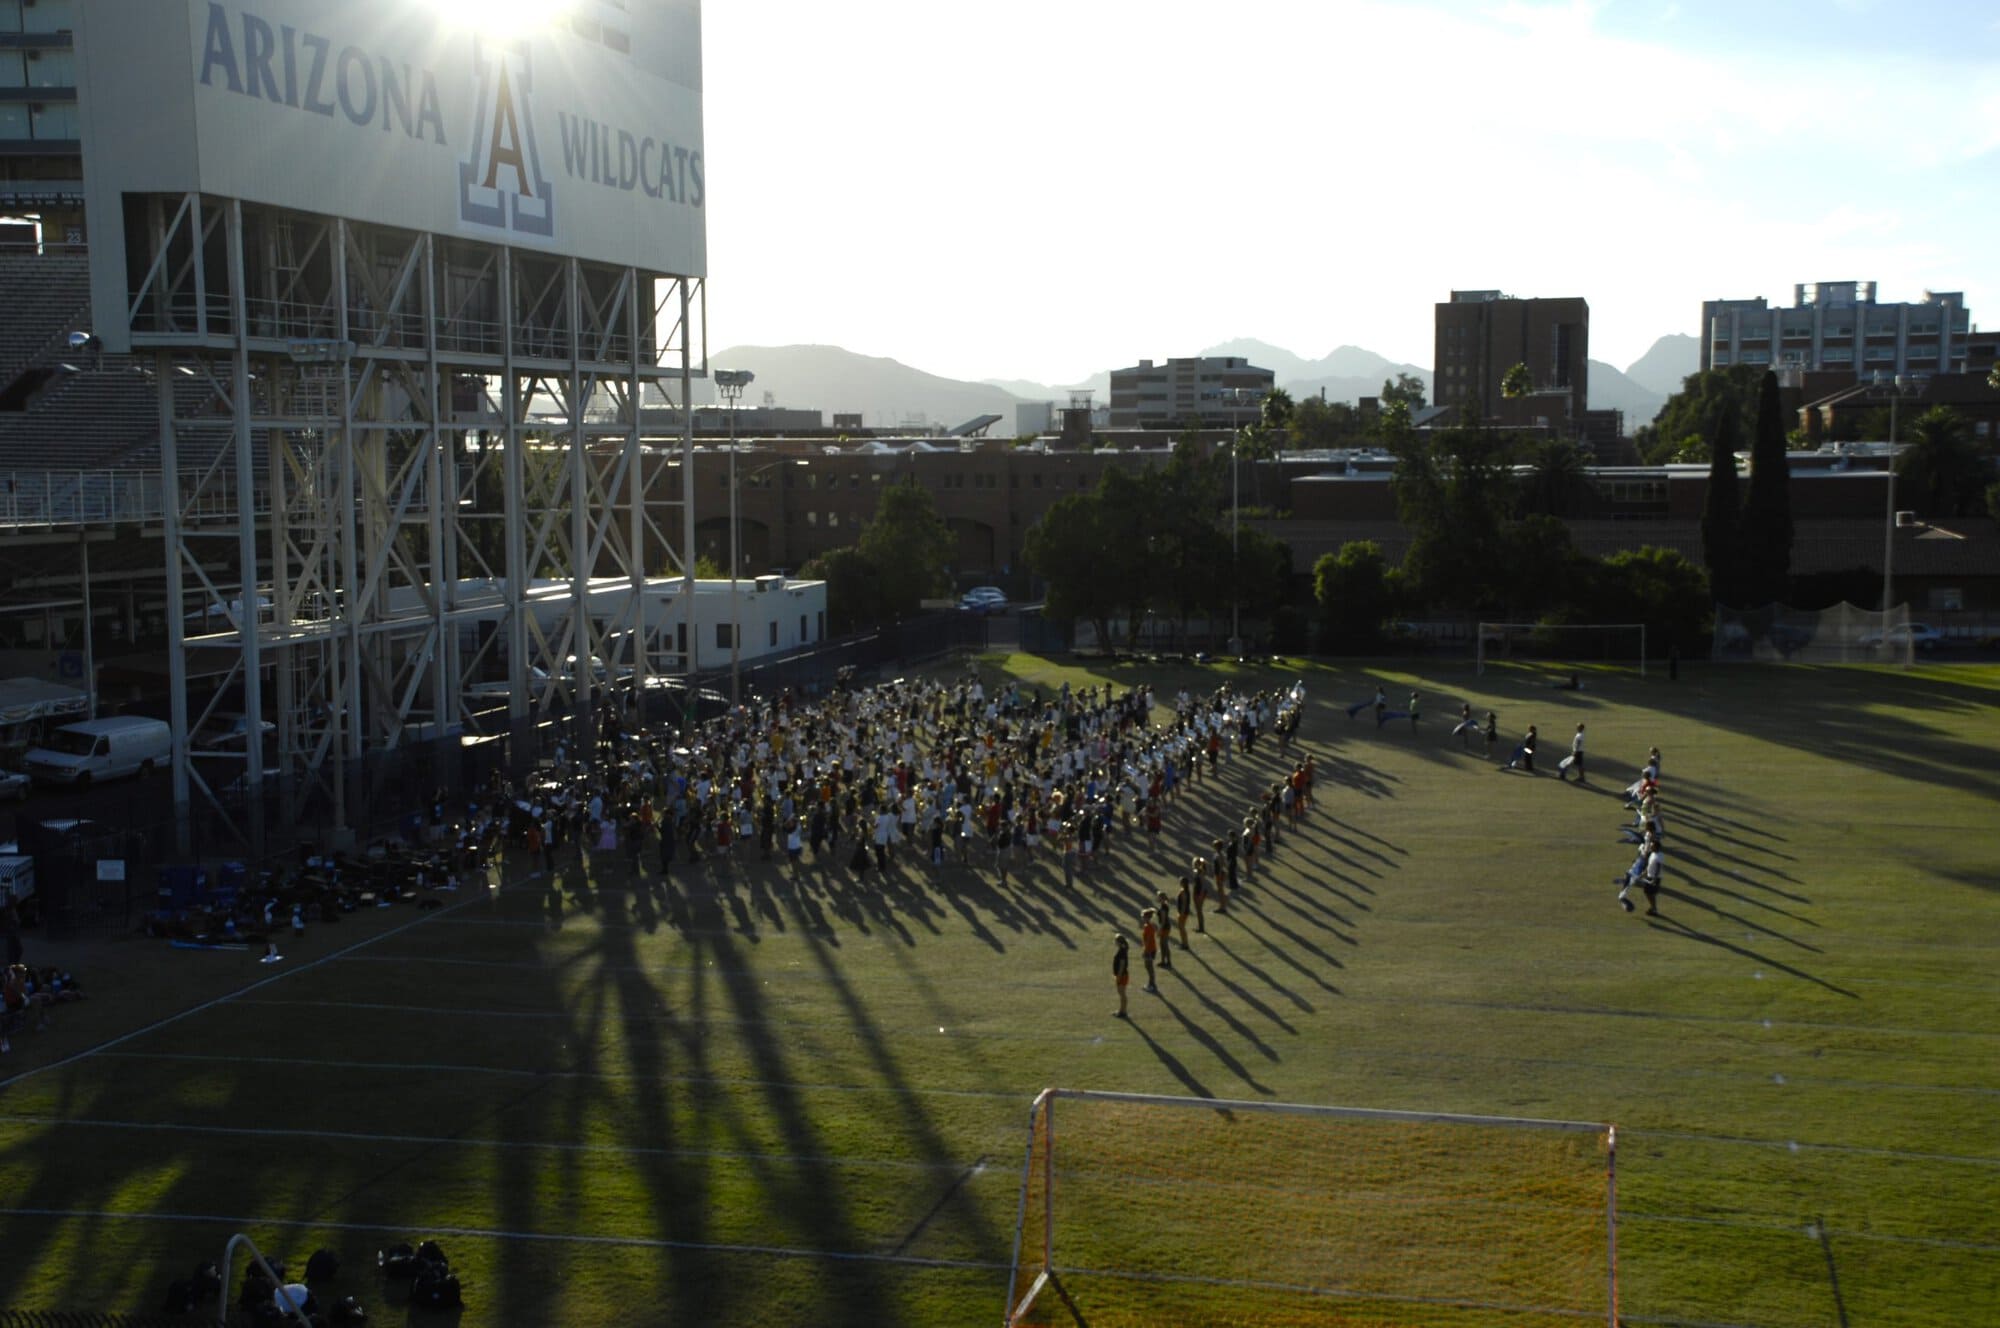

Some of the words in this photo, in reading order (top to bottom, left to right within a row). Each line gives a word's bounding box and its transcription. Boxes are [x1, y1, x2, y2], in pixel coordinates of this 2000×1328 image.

[200, 2, 448, 146] ARIZONA
[459, 34, 553, 237] A
[558, 111, 704, 208] WILDCATS
